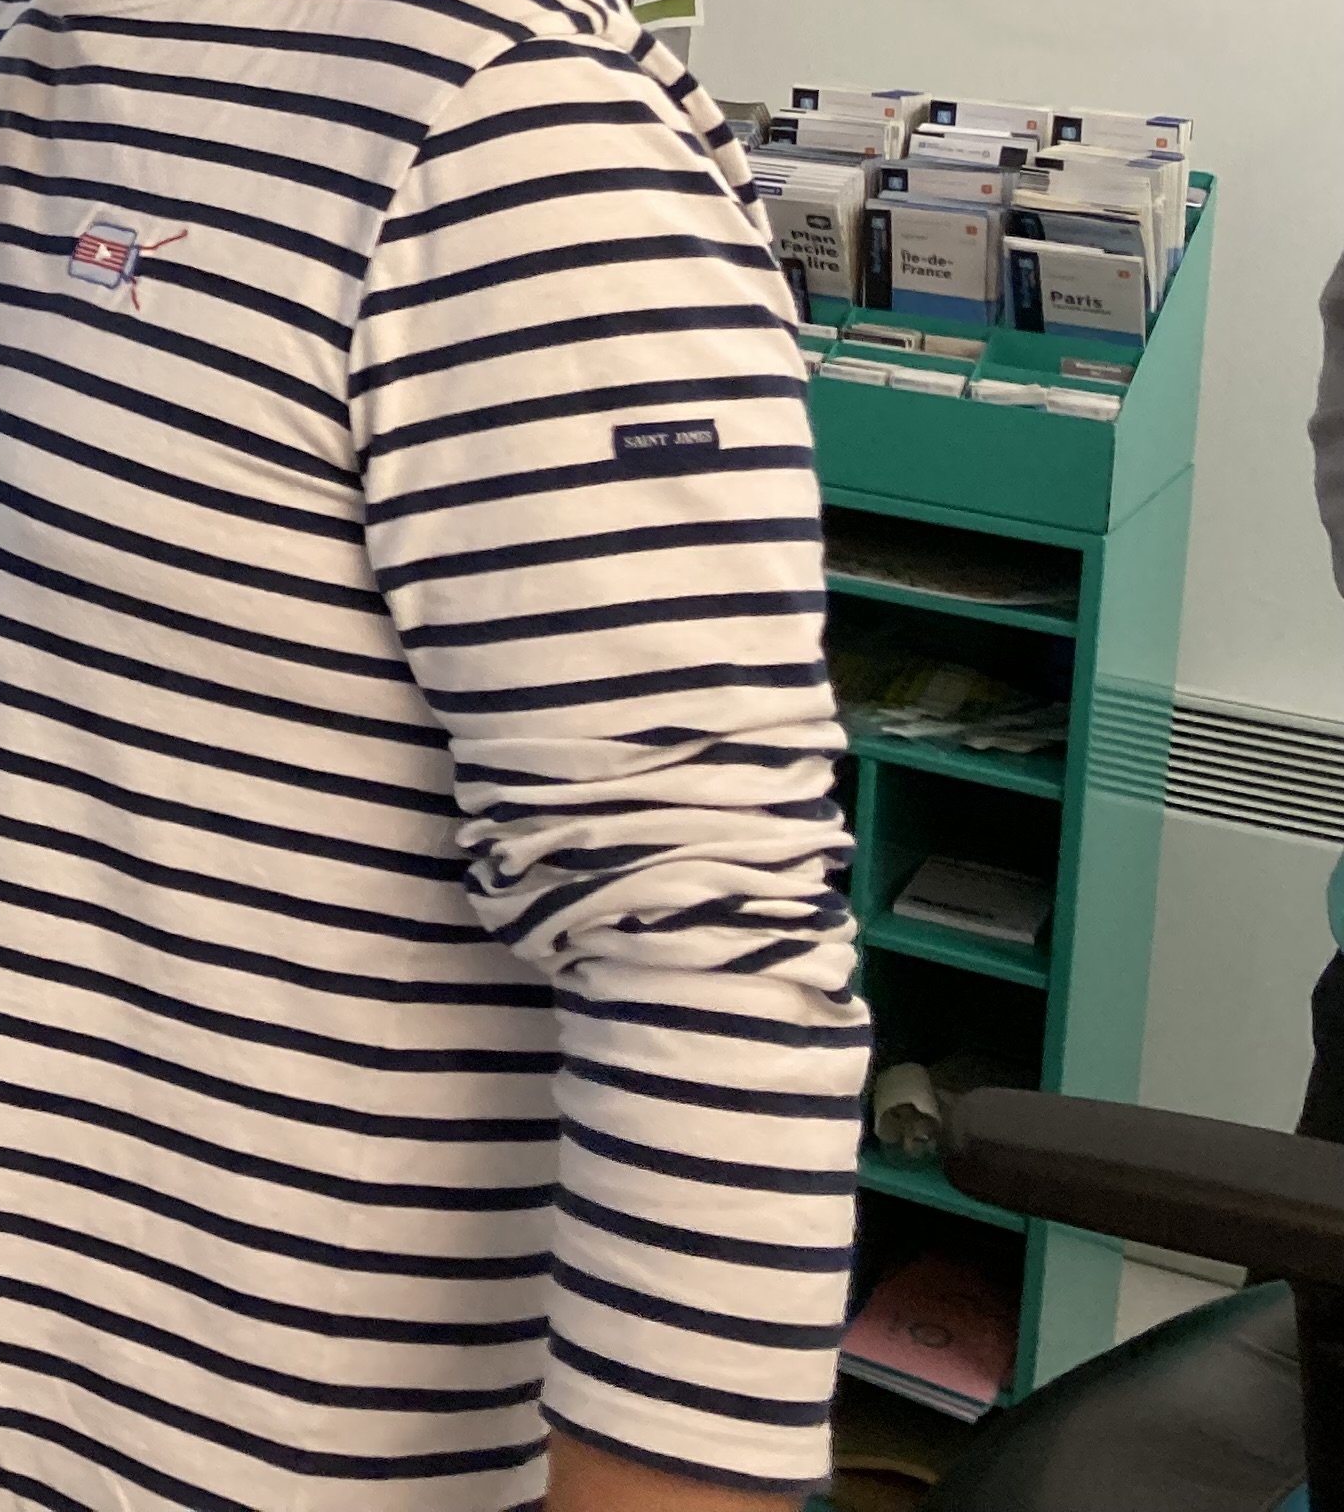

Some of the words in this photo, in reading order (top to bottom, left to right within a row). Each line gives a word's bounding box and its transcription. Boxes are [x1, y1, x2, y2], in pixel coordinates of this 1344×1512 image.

[781, 238, 839, 258] Facile
[901, 261, 952, 280] France
[1050, 289, 1103, 309] Paris
[623, 433, 669, 449] SAINT
